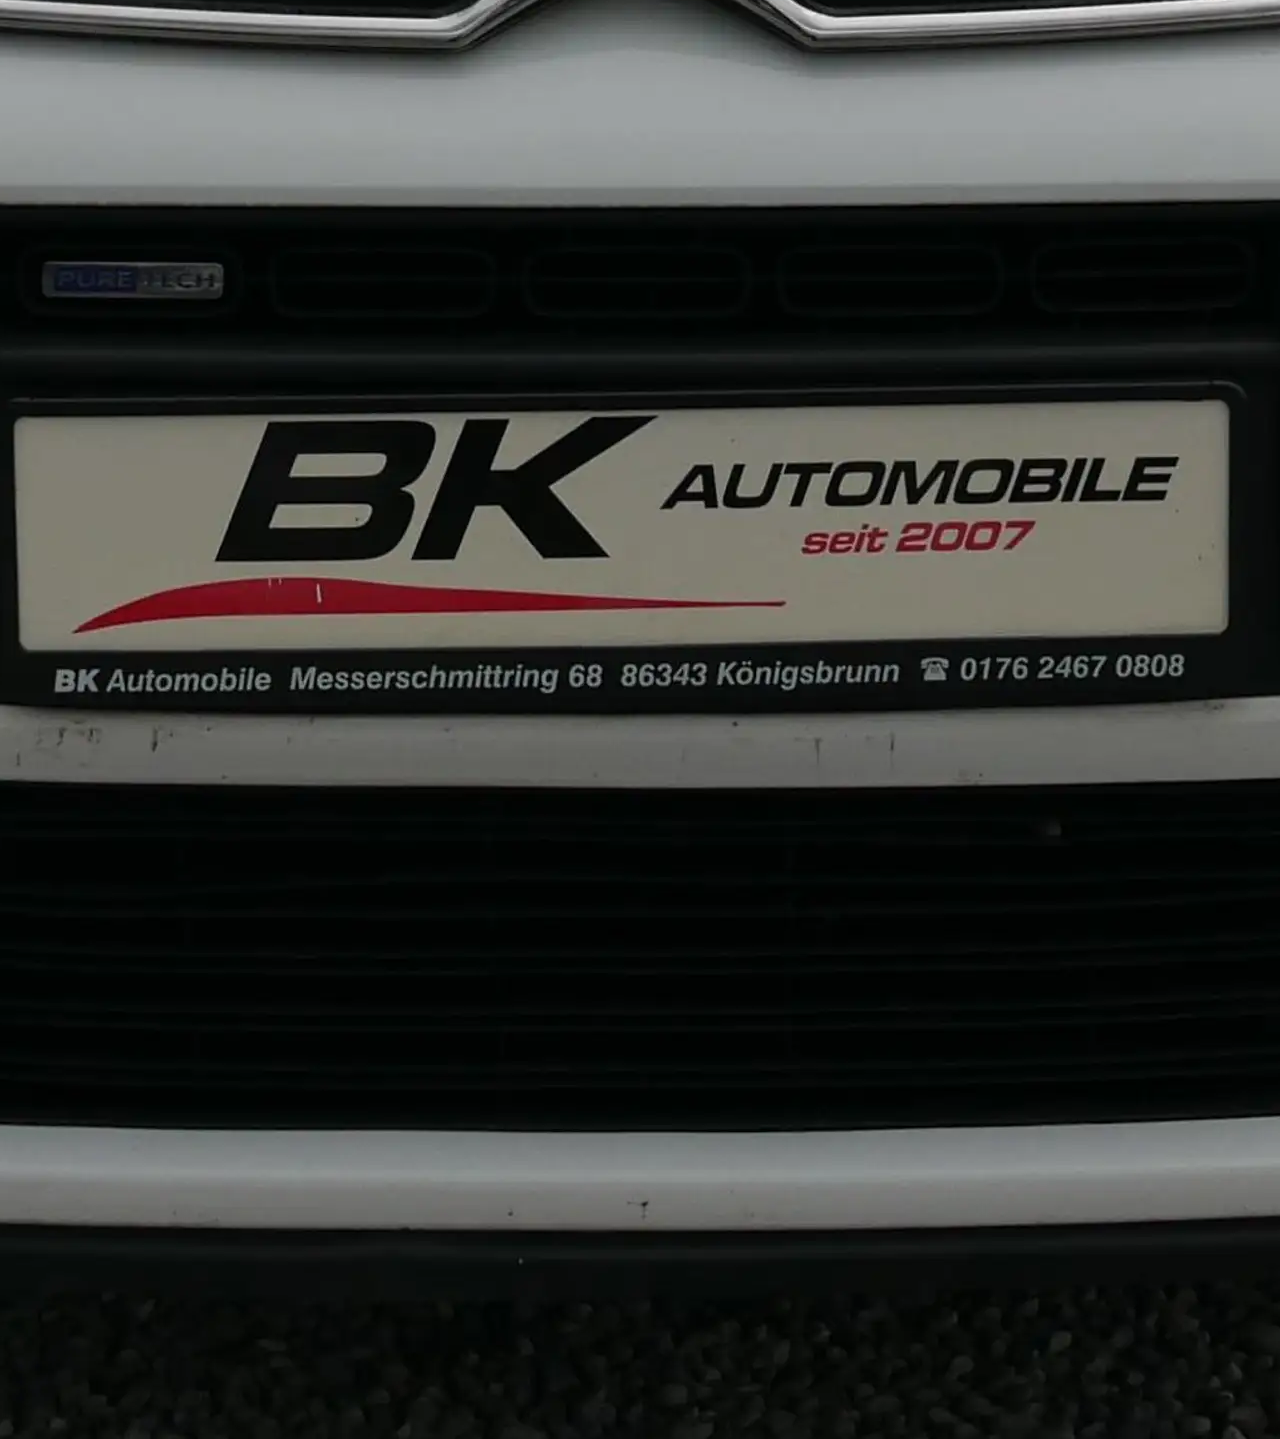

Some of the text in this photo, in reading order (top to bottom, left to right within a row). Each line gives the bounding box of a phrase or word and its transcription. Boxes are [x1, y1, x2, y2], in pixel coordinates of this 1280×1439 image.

[56, 269, 134, 288] PURE
[215, 415, 1180, 562] BK AUTOMOBILE
[801, 519, 1036, 555] seit 2007
[54, 654, 1185, 694] BK Automobile Messerschmittring 68 86343 Königsbrunn 0176 2467 0808
